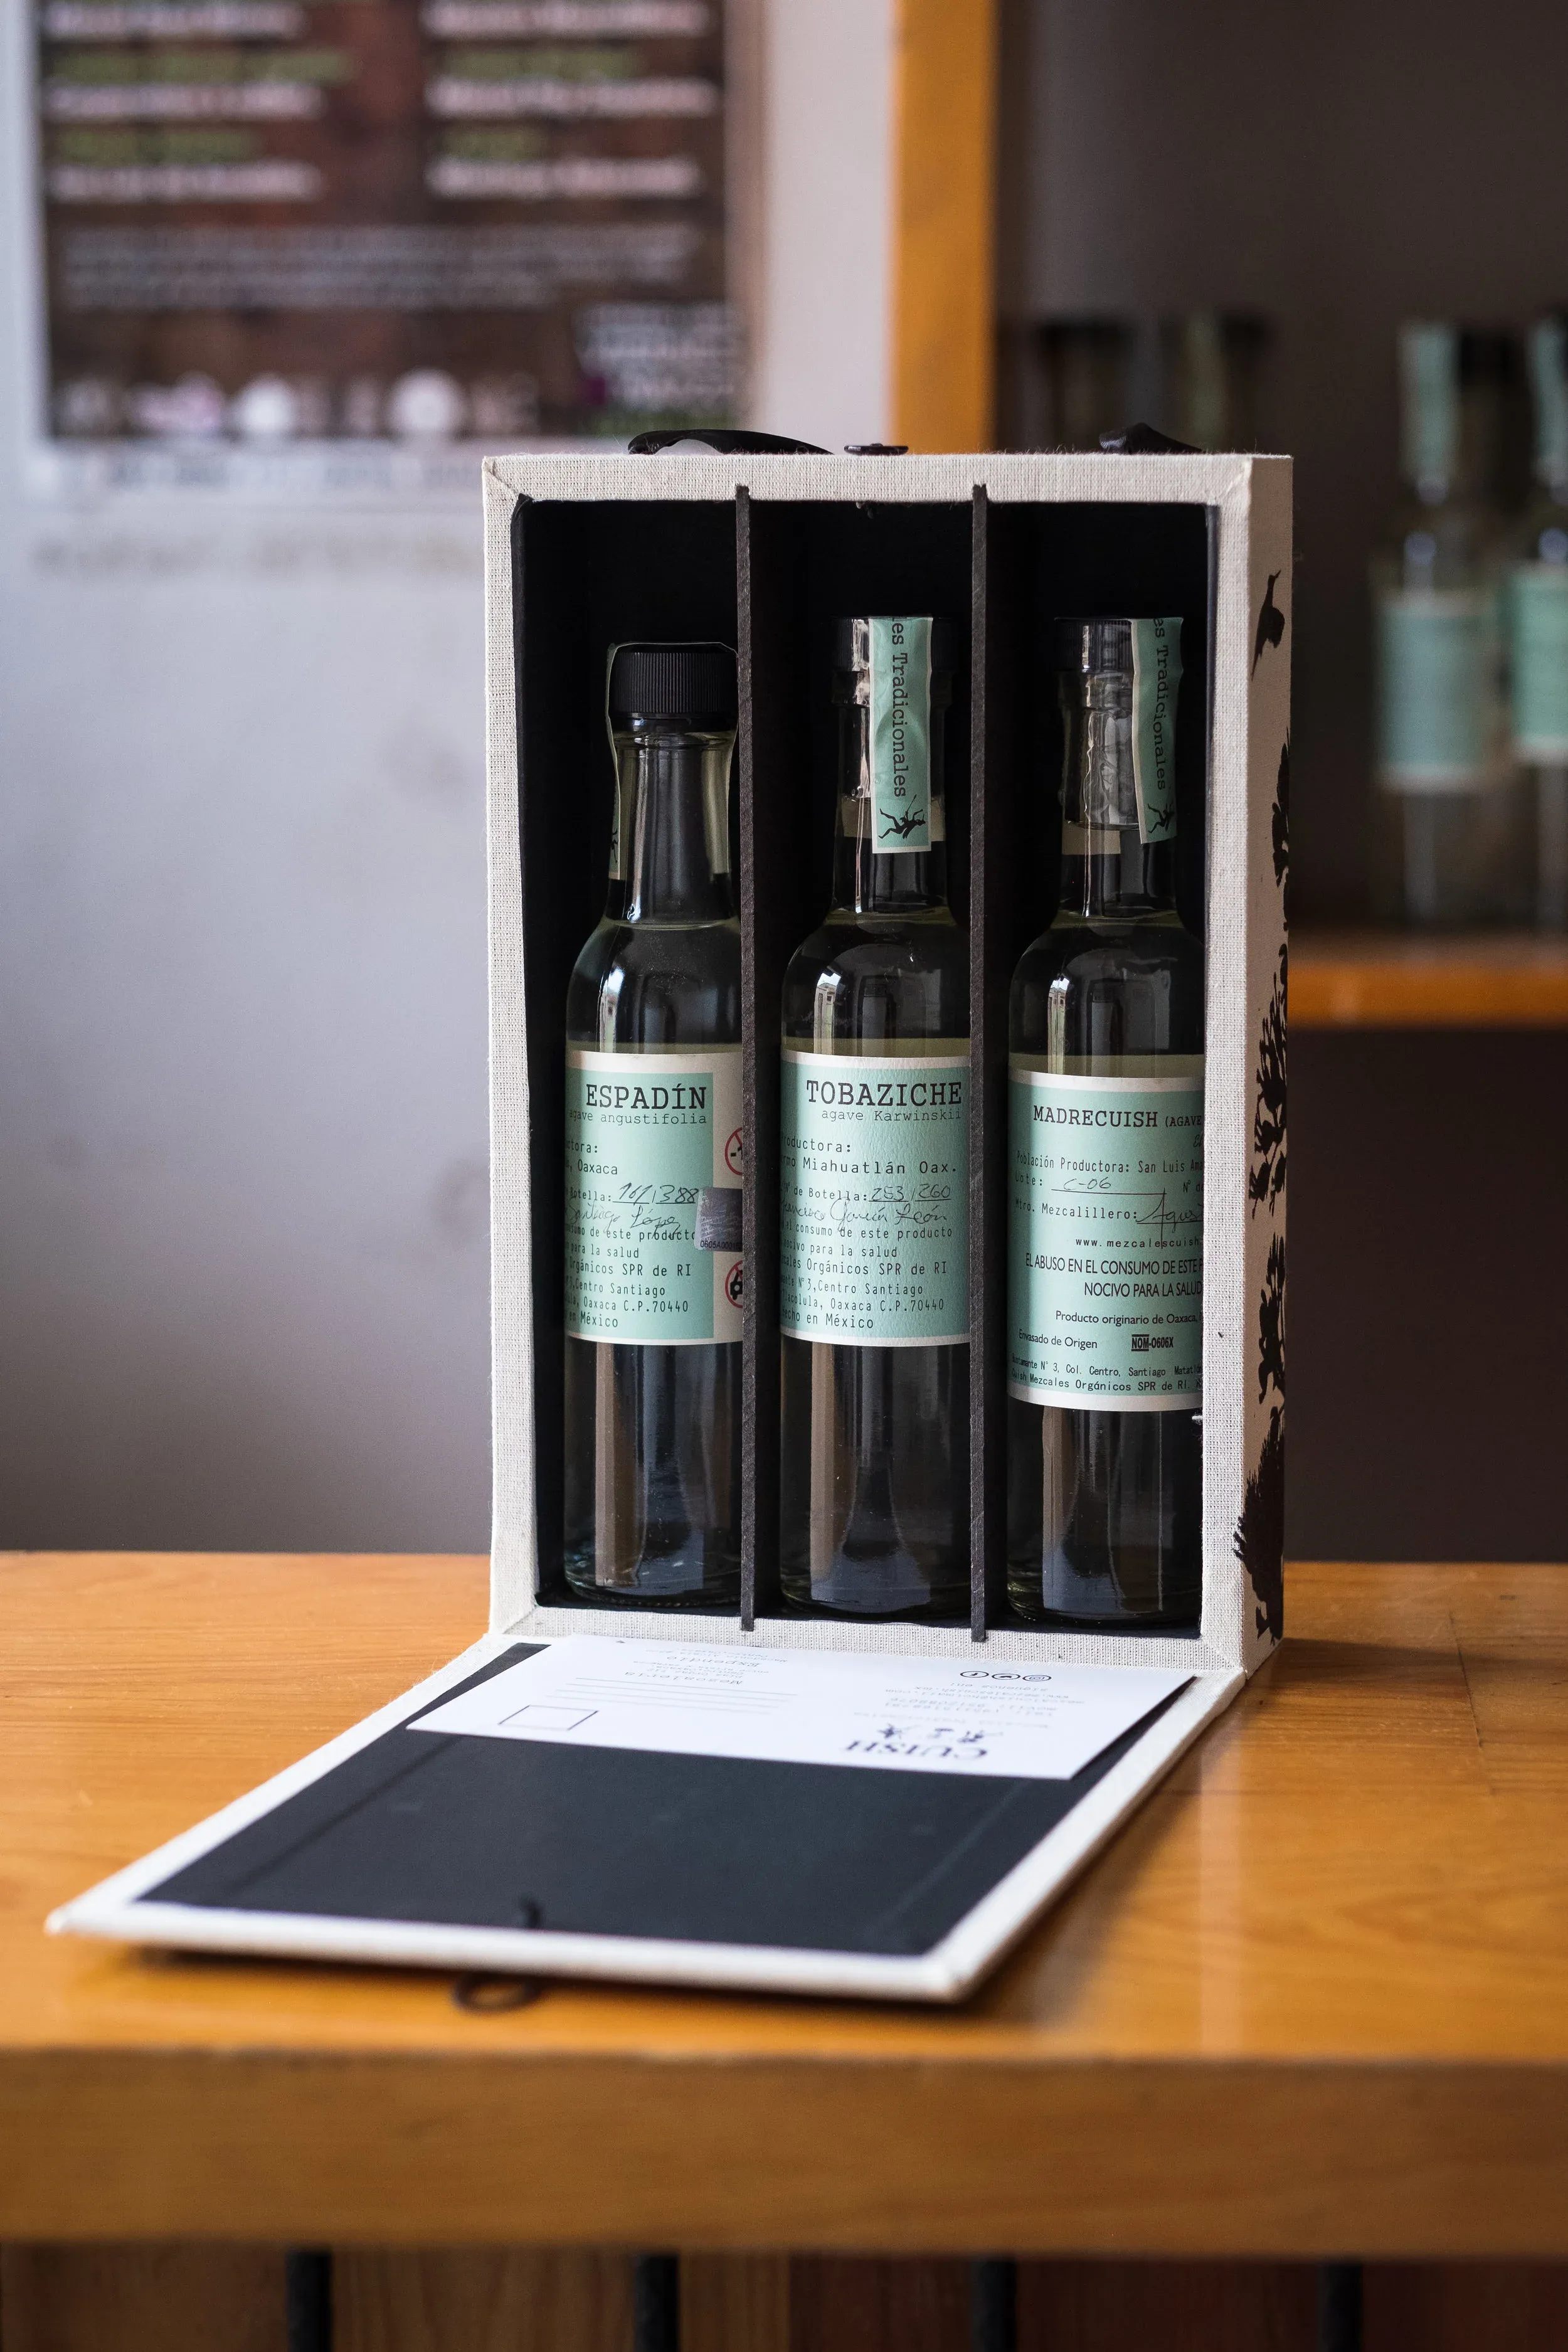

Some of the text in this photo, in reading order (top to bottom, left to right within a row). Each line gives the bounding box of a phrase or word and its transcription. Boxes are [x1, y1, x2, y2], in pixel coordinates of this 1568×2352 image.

[891, 618, 908, 798] es Tradicionales
[1153, 645, 1168, 791] Tradicionales
[586, 1083, 707, 1110] ESPADÍN
[807, 1079, 961, 1106] TOBAZICHE
[569, 1109, 707, 1126] agave angustifolia
[822, 1110, 961, 1121] agave Karwinskii
[1033, 1104, 1158, 1128] MADRECUISH
[578, 1159, 618, 1175] Oaxaca
[803, 1157, 905, 1174] Miahuatlán
[919, 1160, 956, 1174] Oax.
[1016, 1150, 1054, 1168] Población
[1061, 1157, 1130, 1173] Productora:
[1138, 1160, 1156, 1173] San
[1163, 1160, 1185, 1173] Luis
[1015, 1172, 1043, 1187] Lote:
[793, 1185, 803, 1196] de
[808, 1187, 867, 1202] Botella:
[1014, 1197, 1137, 1219] Mtro. Mezcalillero:
[590, 1227, 600, 1237] de
[607, 1229, 631, 1239] este
[796, 1223, 833, 1237] consumo
[840, 1226, 852, 1237] de
[861, 1229, 889, 1239] este
[898, 1227, 952, 1241] producto
[591, 1244, 600, 1256] la
[607, 1248, 639, 1258] salud
[810, 1245, 832, 1256] para
[841, 1245, 853, 1256] la
[861, 1246, 898, 1258] salud
[622, 1264, 643, 1276] SPR
[652, 1264, 667, 1276] de
[677, 1264, 691, 1276] RI
[807, 1258, 869, 1275] Orgánicos
[879, 1263, 901, 1275] SPR
[911, 1263, 925, 1275] de
[934, 1261, 946, 1274] RI
[1025, 1253, 1034, 1268] EL
[1034, 1254, 1066, 1271] ABUSO
[1068, 1258, 1083, 1273] EN
[1086, 1259, 1098, 1274] EL
[1101, 1260, 1160, 1275] CONSUMO
[1163, 1260, 1175, 1274] DE
[1179, 1259, 1197, 1273] ESTE
[610, 1283, 665, 1298] Santiago
[865, 1283, 923, 1297] Santiago
[1084, 1281, 1130, 1298] NOCIVO
[1133, 1283, 1159, 1298] PARA
[1162, 1283, 1174, 1297] LA
[583, 1297, 617, 1311] Oaxaca
[623, 1300, 689, 1312] C.P.70440
[830, 1300, 871, 1311] Oaxaca
[880, 1299, 944, 1312] C.P.70440
[580, 1310, 618, 1328] México
[807, 1314, 818, 1325] en
[825, 1312, 874, 1329] México
[1056, 1310, 1099, 1323] Producto
[1102, 1314, 1149, 1327] originario
[1152, 1314, 1163, 1324] de
[1166, 1313, 1198, 1323] Oaxaca,
[1019, 1328, 1098, 1350] Envasado de Origen
[1066, 1364, 1082, 1374] Col.
[1089, 1365, 1121, 1377] Centro,
[1128, 1367, 1166, 1382] Santiago
[1029, 1372, 1069, 1388] Mezcales
[1075, 1378, 1131, 1392] Orgánicos
[1138, 1381, 1156, 1391] SPR
[1162, 1382, 1173, 1391] de
